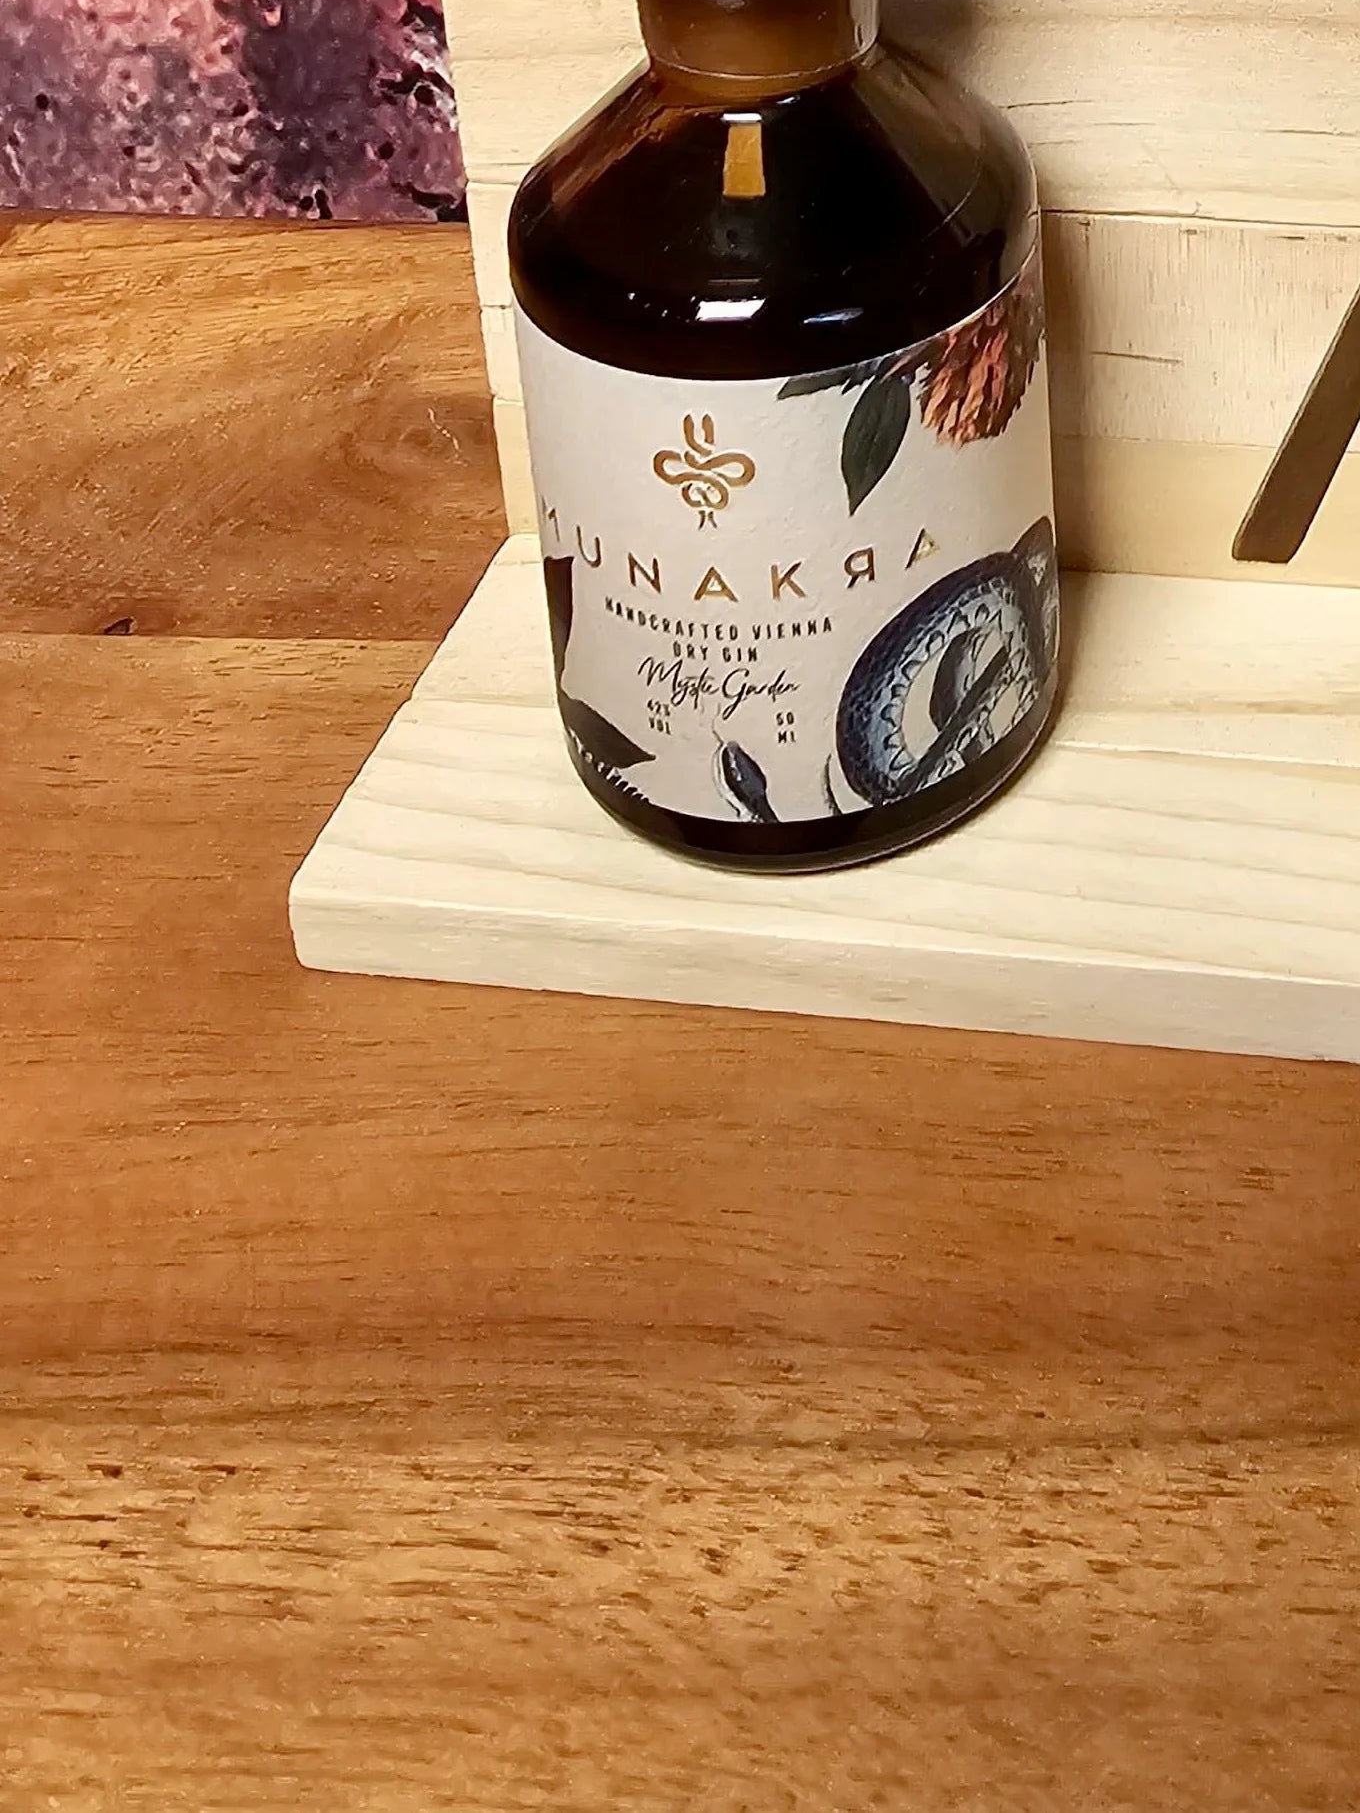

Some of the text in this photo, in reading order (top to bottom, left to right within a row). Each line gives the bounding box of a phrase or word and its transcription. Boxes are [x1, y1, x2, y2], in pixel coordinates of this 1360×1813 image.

[604, 596, 833, 641] HANDCRAFTED VIENNA
[672, 639, 759, 663] DRY GIN
[721, 668, 801, 721] Garden
